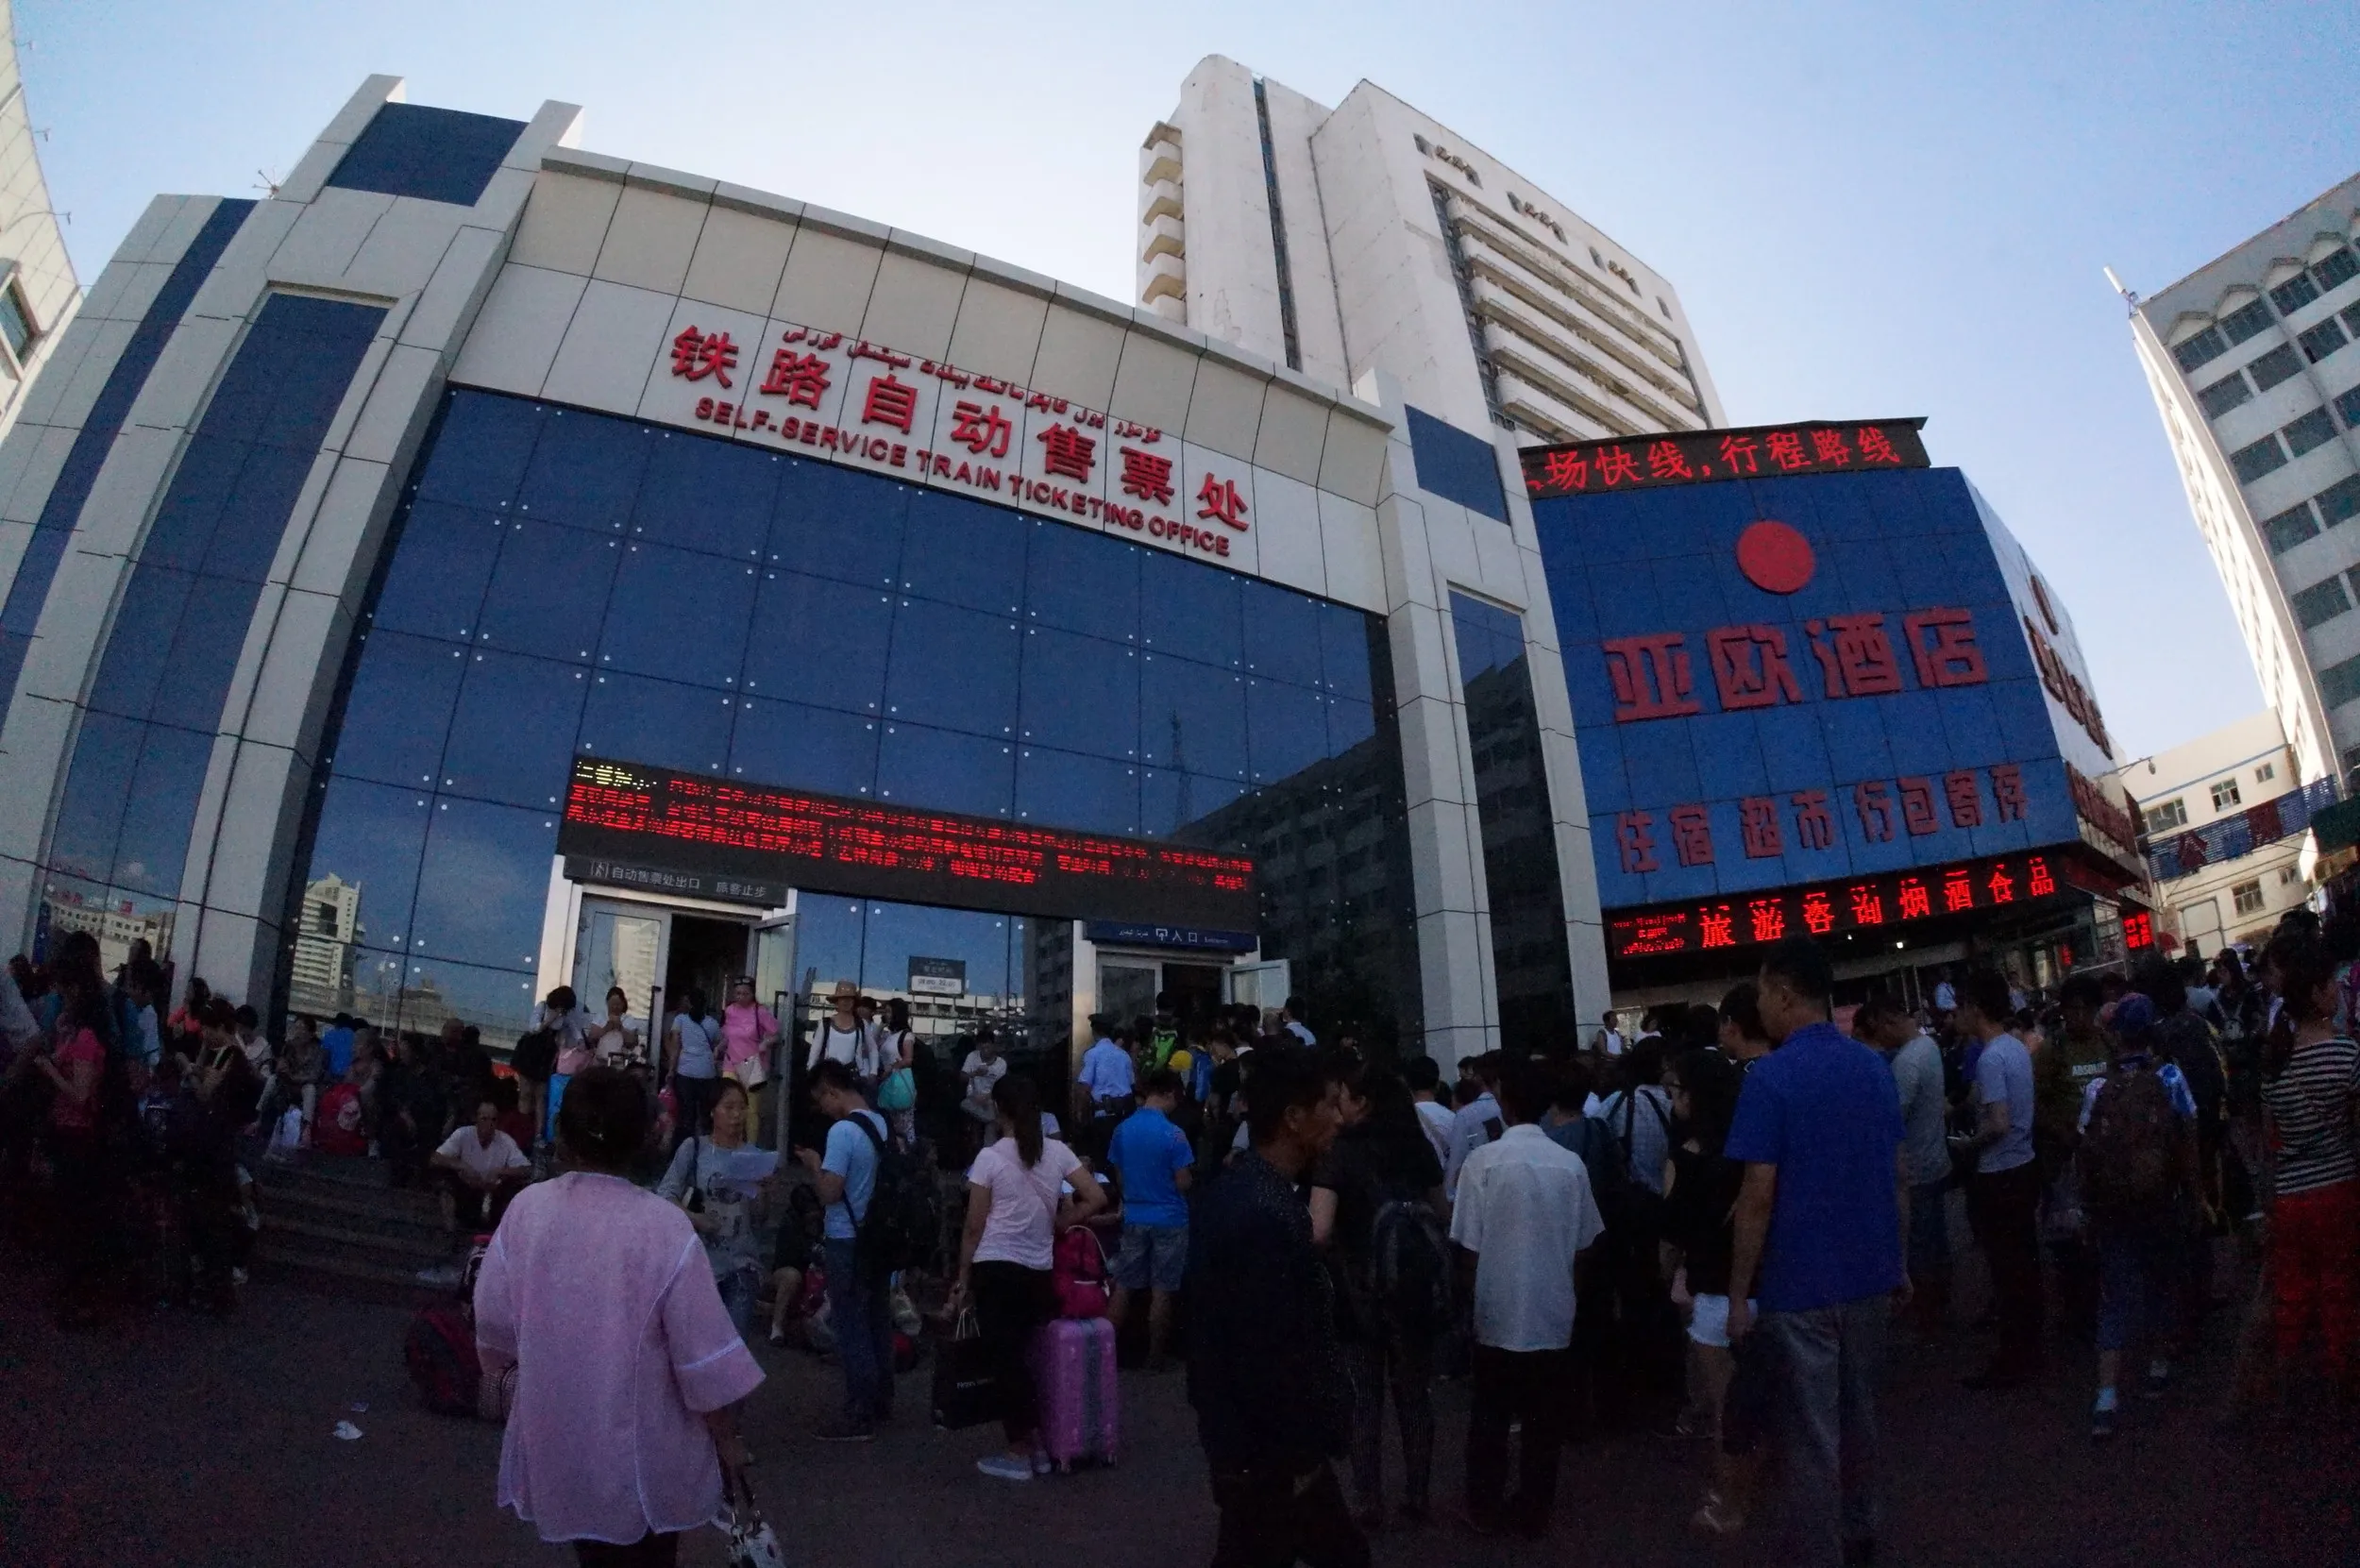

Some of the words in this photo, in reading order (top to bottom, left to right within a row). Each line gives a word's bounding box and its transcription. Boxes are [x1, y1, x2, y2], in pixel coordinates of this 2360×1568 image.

[670, 325, 1250, 532] 铁路自动售票处
[695, 396, 907, 467] SELF-SERVICE
[917, 448, 1001, 491] TRAIN
[1008, 474, 1144, 531] TICKETING
[1148, 516, 1231, 557] OFFICE
[1522, 426, 1900, 491] 场快线,行程路线
[1604, 606, 1988, 724] 亚欧酒店
